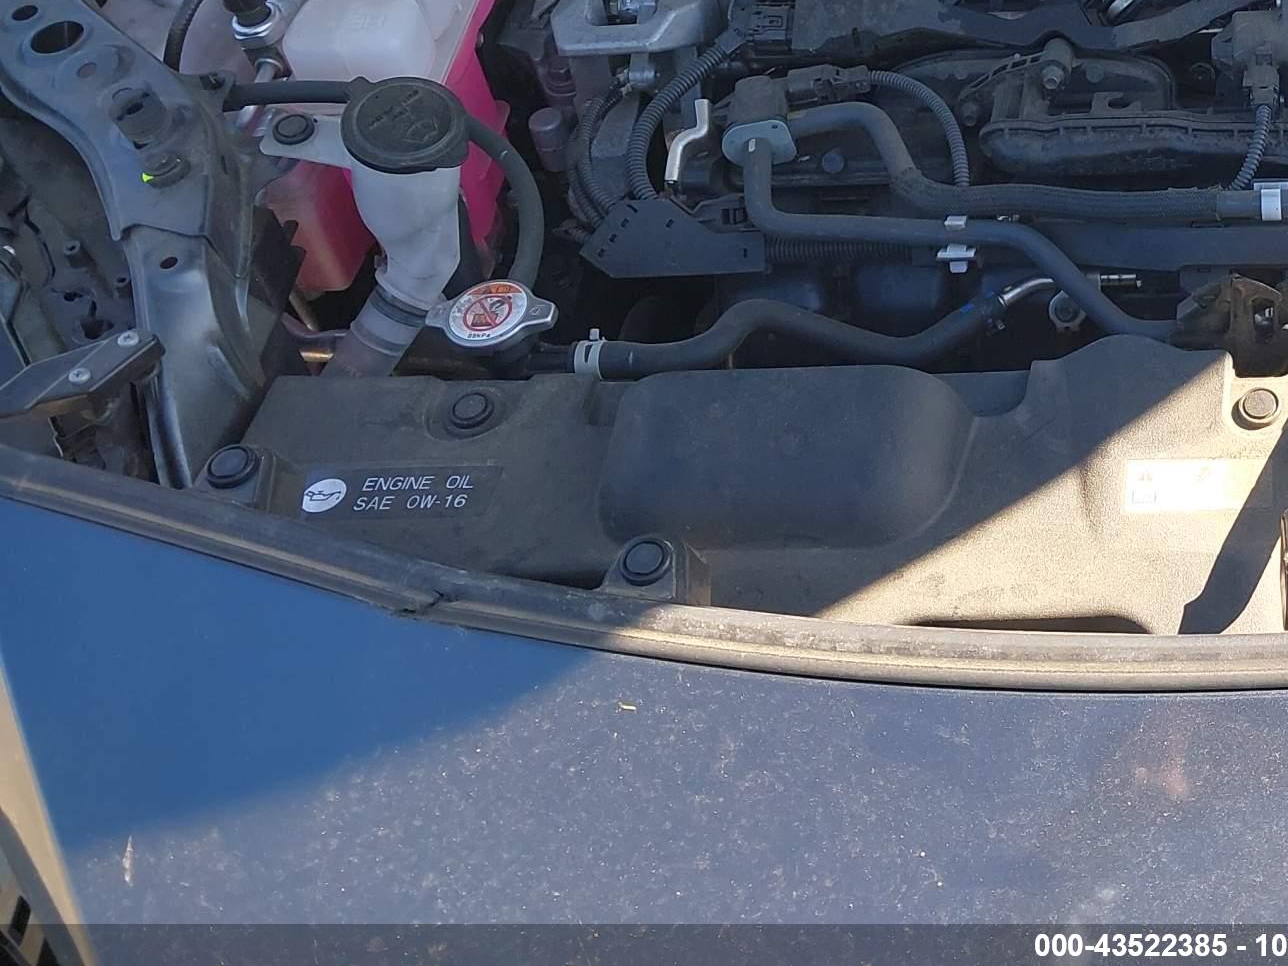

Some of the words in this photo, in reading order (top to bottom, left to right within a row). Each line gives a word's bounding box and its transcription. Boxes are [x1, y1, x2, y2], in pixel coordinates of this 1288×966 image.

[361, 475, 435, 492] ENGINE
[445, 474, 475, 490] OIL
[353, 495, 396, 511] SAE
[406, 493, 469, 510] 0W-16
